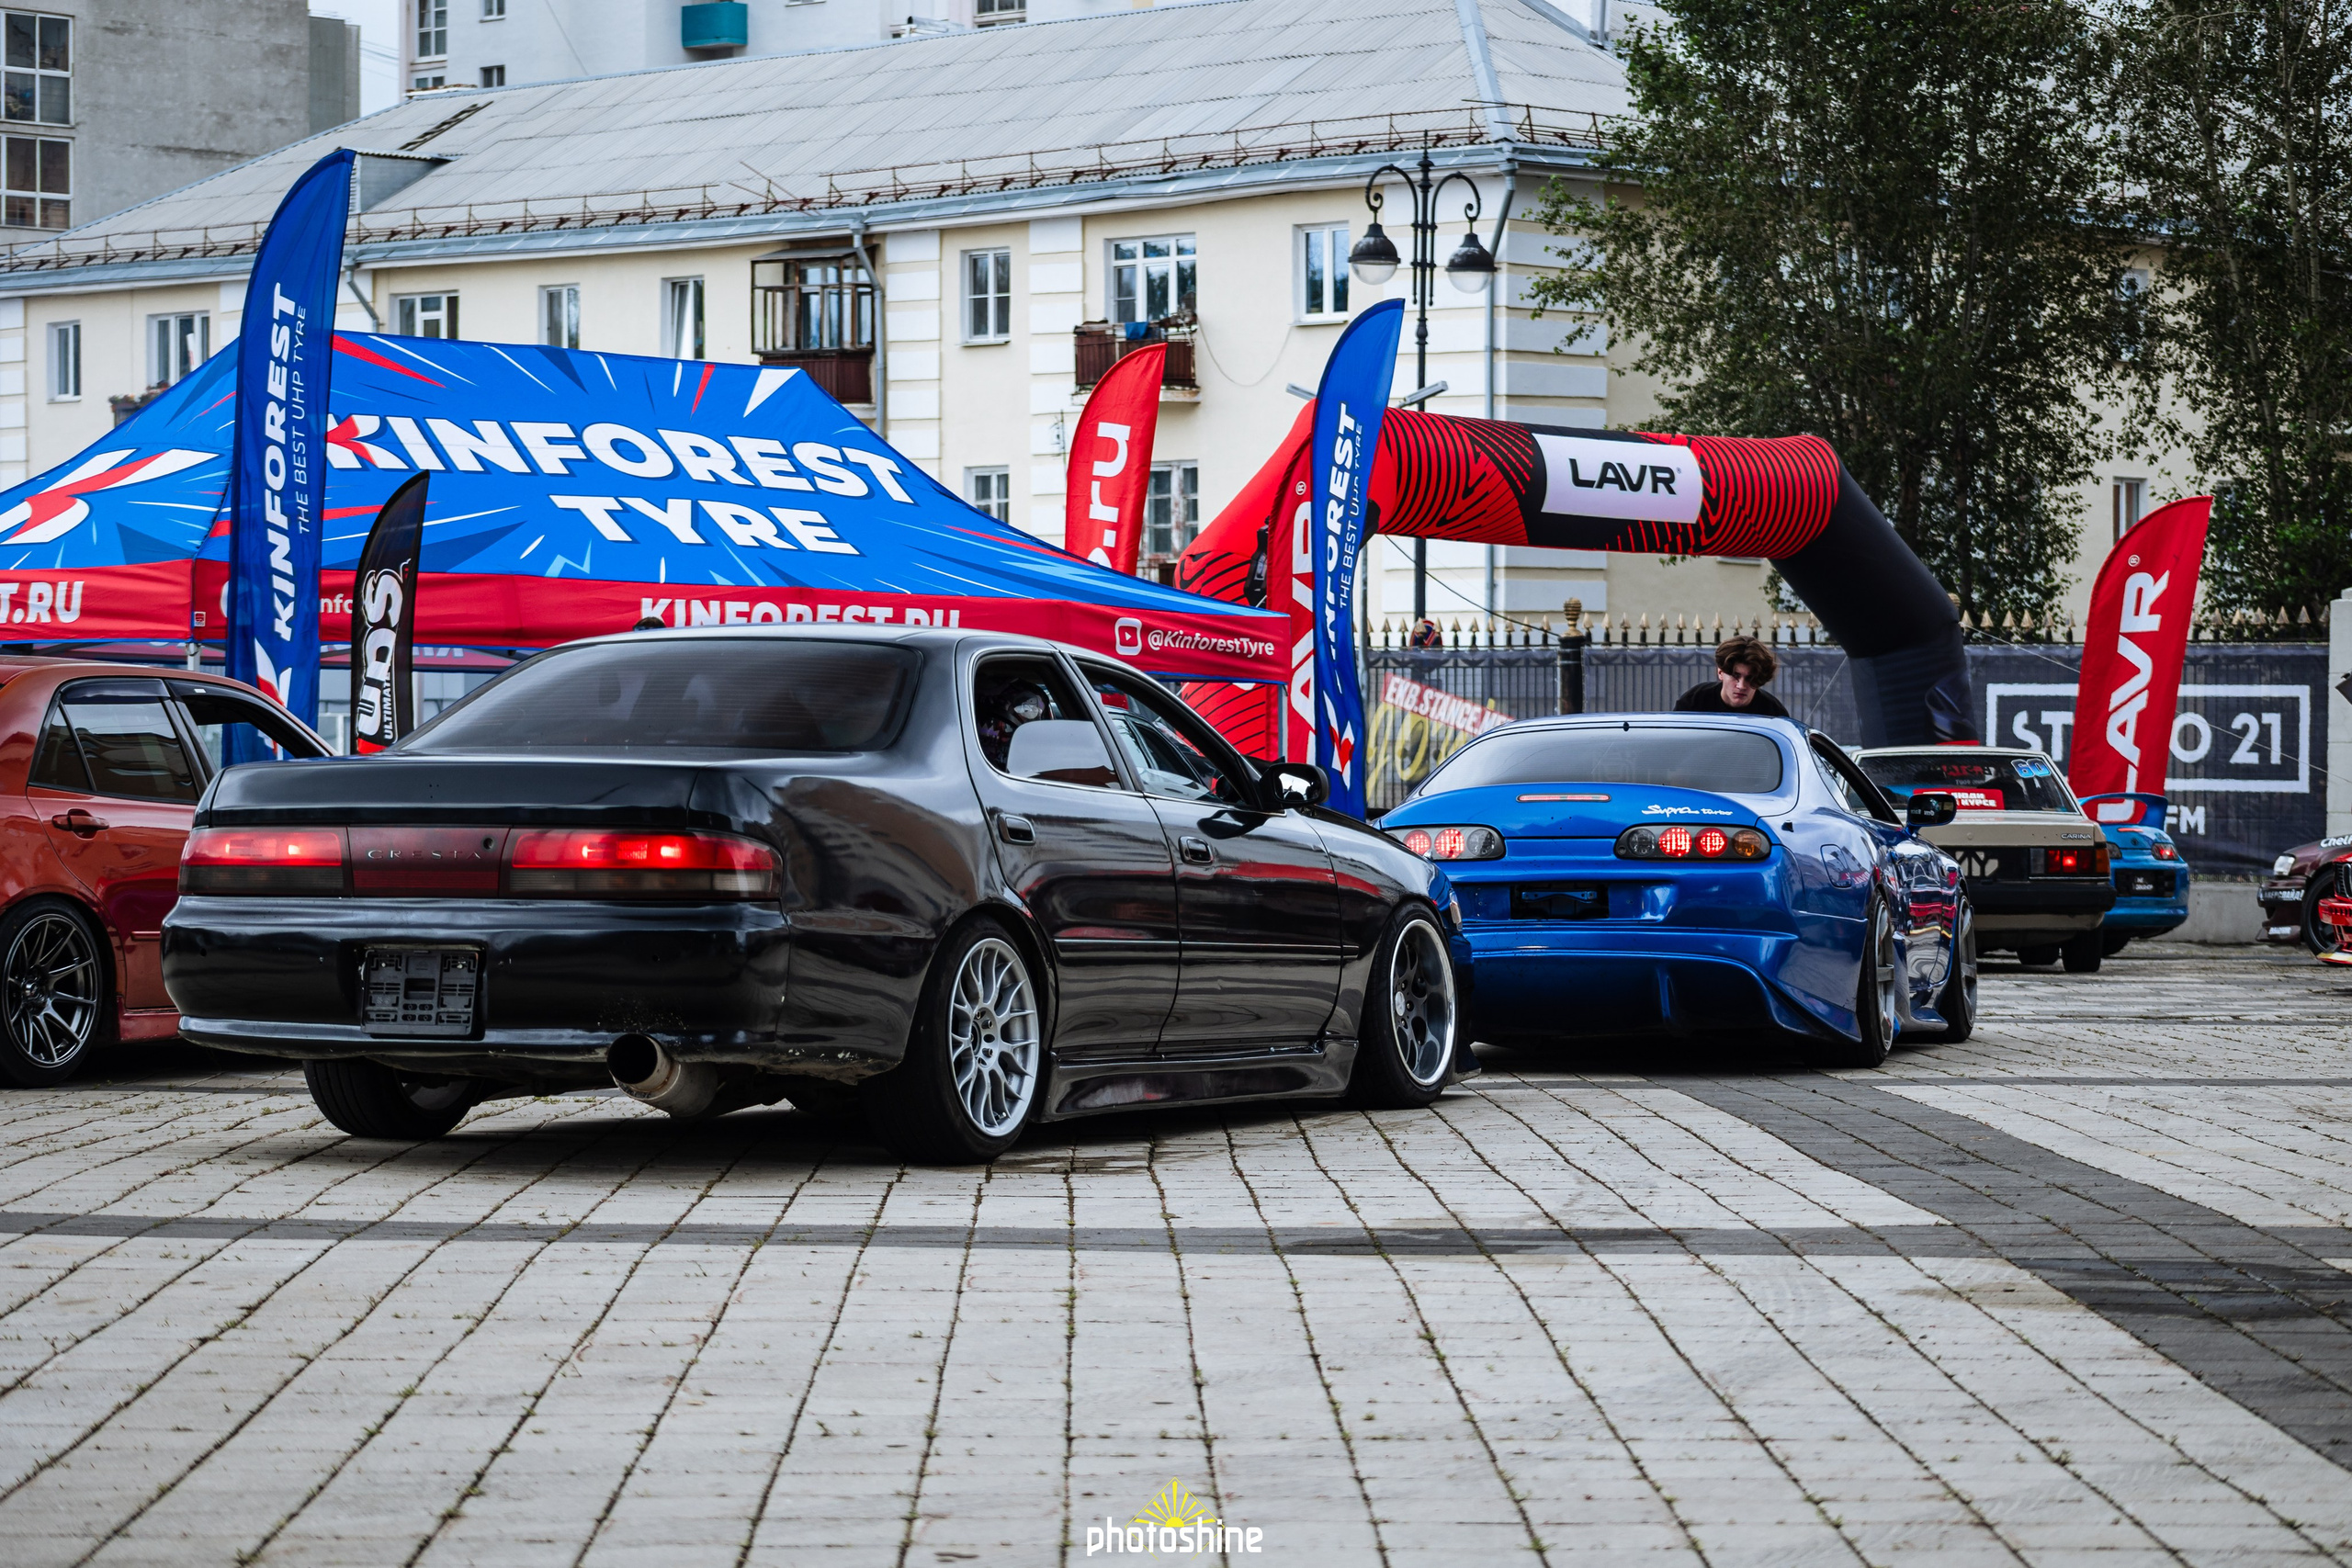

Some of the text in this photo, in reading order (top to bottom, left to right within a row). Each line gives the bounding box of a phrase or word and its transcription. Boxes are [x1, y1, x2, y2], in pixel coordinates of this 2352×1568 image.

[292, 306, 311, 534] THE BEST UHP TYRE
[264, 282, 296, 641] KINFOREST
[325, 412, 915, 504] KINFOREST
[1568, 458, 1677, 495] LAVR
[549, 494, 861, 556] TYRE
[1342, 521, 1358, 568] BEST
[1340, 572, 1351, 608] THE
[1148, 630, 1275, 658] @KinforestTyre
[2097, 570, 2169, 822] LAVR
[2229, 713, 2282, 765] 21
[2011, 758, 2052, 778] 60
[1641, 805, 1700, 818] Supra
[2165, 805, 2205, 835] FM
[368, 850, 481, 860] CRESTA
